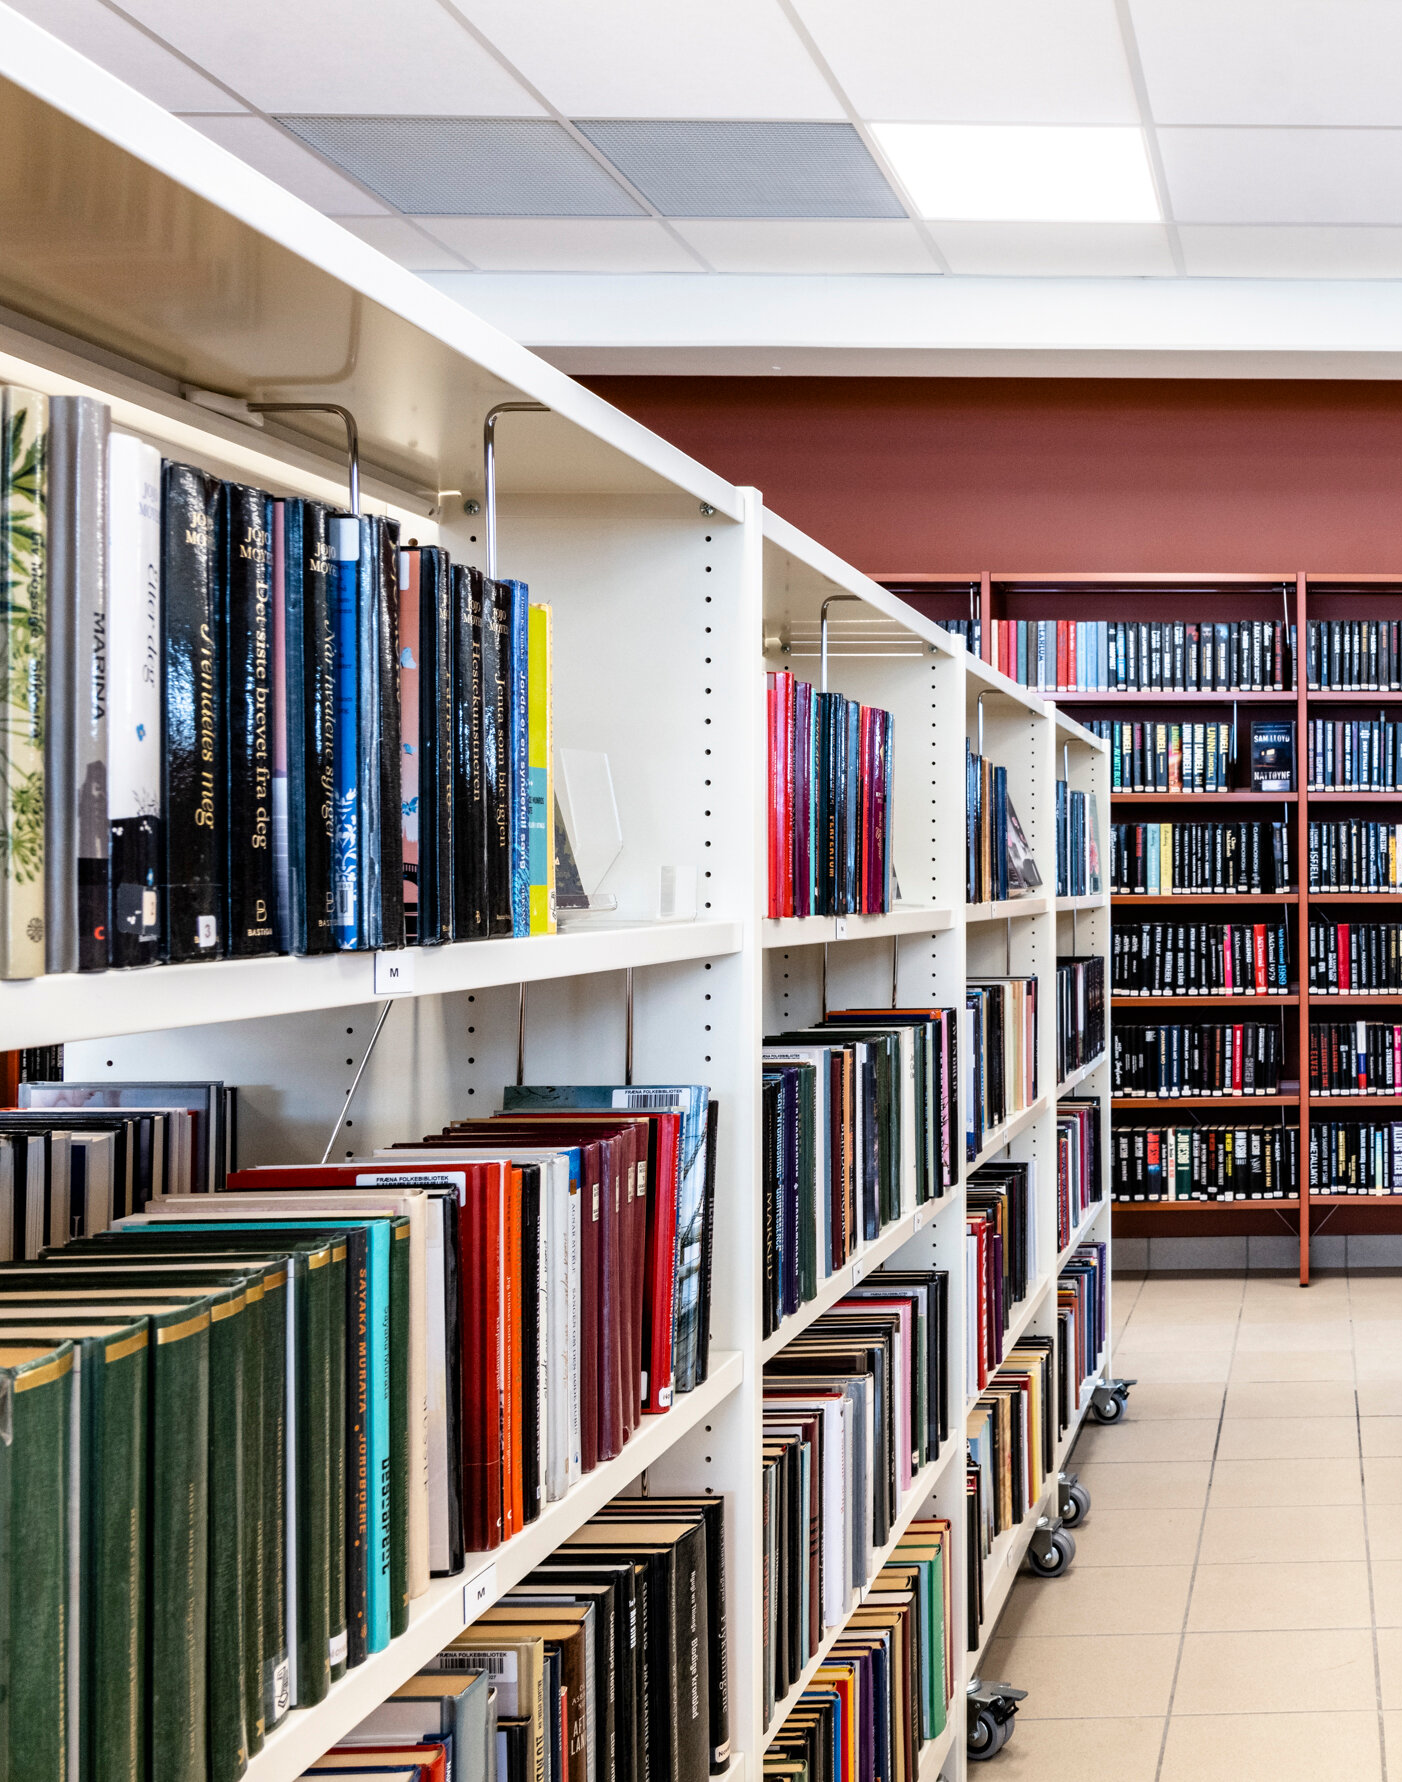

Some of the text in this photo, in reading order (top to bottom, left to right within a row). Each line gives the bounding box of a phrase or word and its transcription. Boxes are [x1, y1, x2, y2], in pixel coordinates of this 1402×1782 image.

[94, 612, 106, 720] MARINA
[143, 635, 158, 688] deg
[194, 624, 217, 829] Fremdeles meg
[251, 580, 271, 849] Det siste brevet fra deg
[321, 620, 337, 843] Når hvalene synger
[471, 641, 482, 802] Hestekunstneren
[1123, 725, 1132, 754] LINDELL
[1207, 727, 1216, 752] UNNI
[1253, 735, 1291, 743] SAM LLOYD
[494, 673, 507, 847] Jenta som ble igjen
[518, 671, 528, 868] Jorda er en syndefull sang
[1194, 724, 1204, 775] UNNI LINDELL
[1310, 851, 1319, 881] ISFJELL
[389, 968, 399, 978] M
[398, 1175, 449, 1183] FOLKEBIBLIOTEK
[1310, 1141, 1318, 1185] METALLMYK
[359, 1268, 367, 1534] SAYAKA MURATA JORDBOERE
[477, 1587, 486, 1600] M
[689, 1637, 699, 1719] Blodige kronblad
